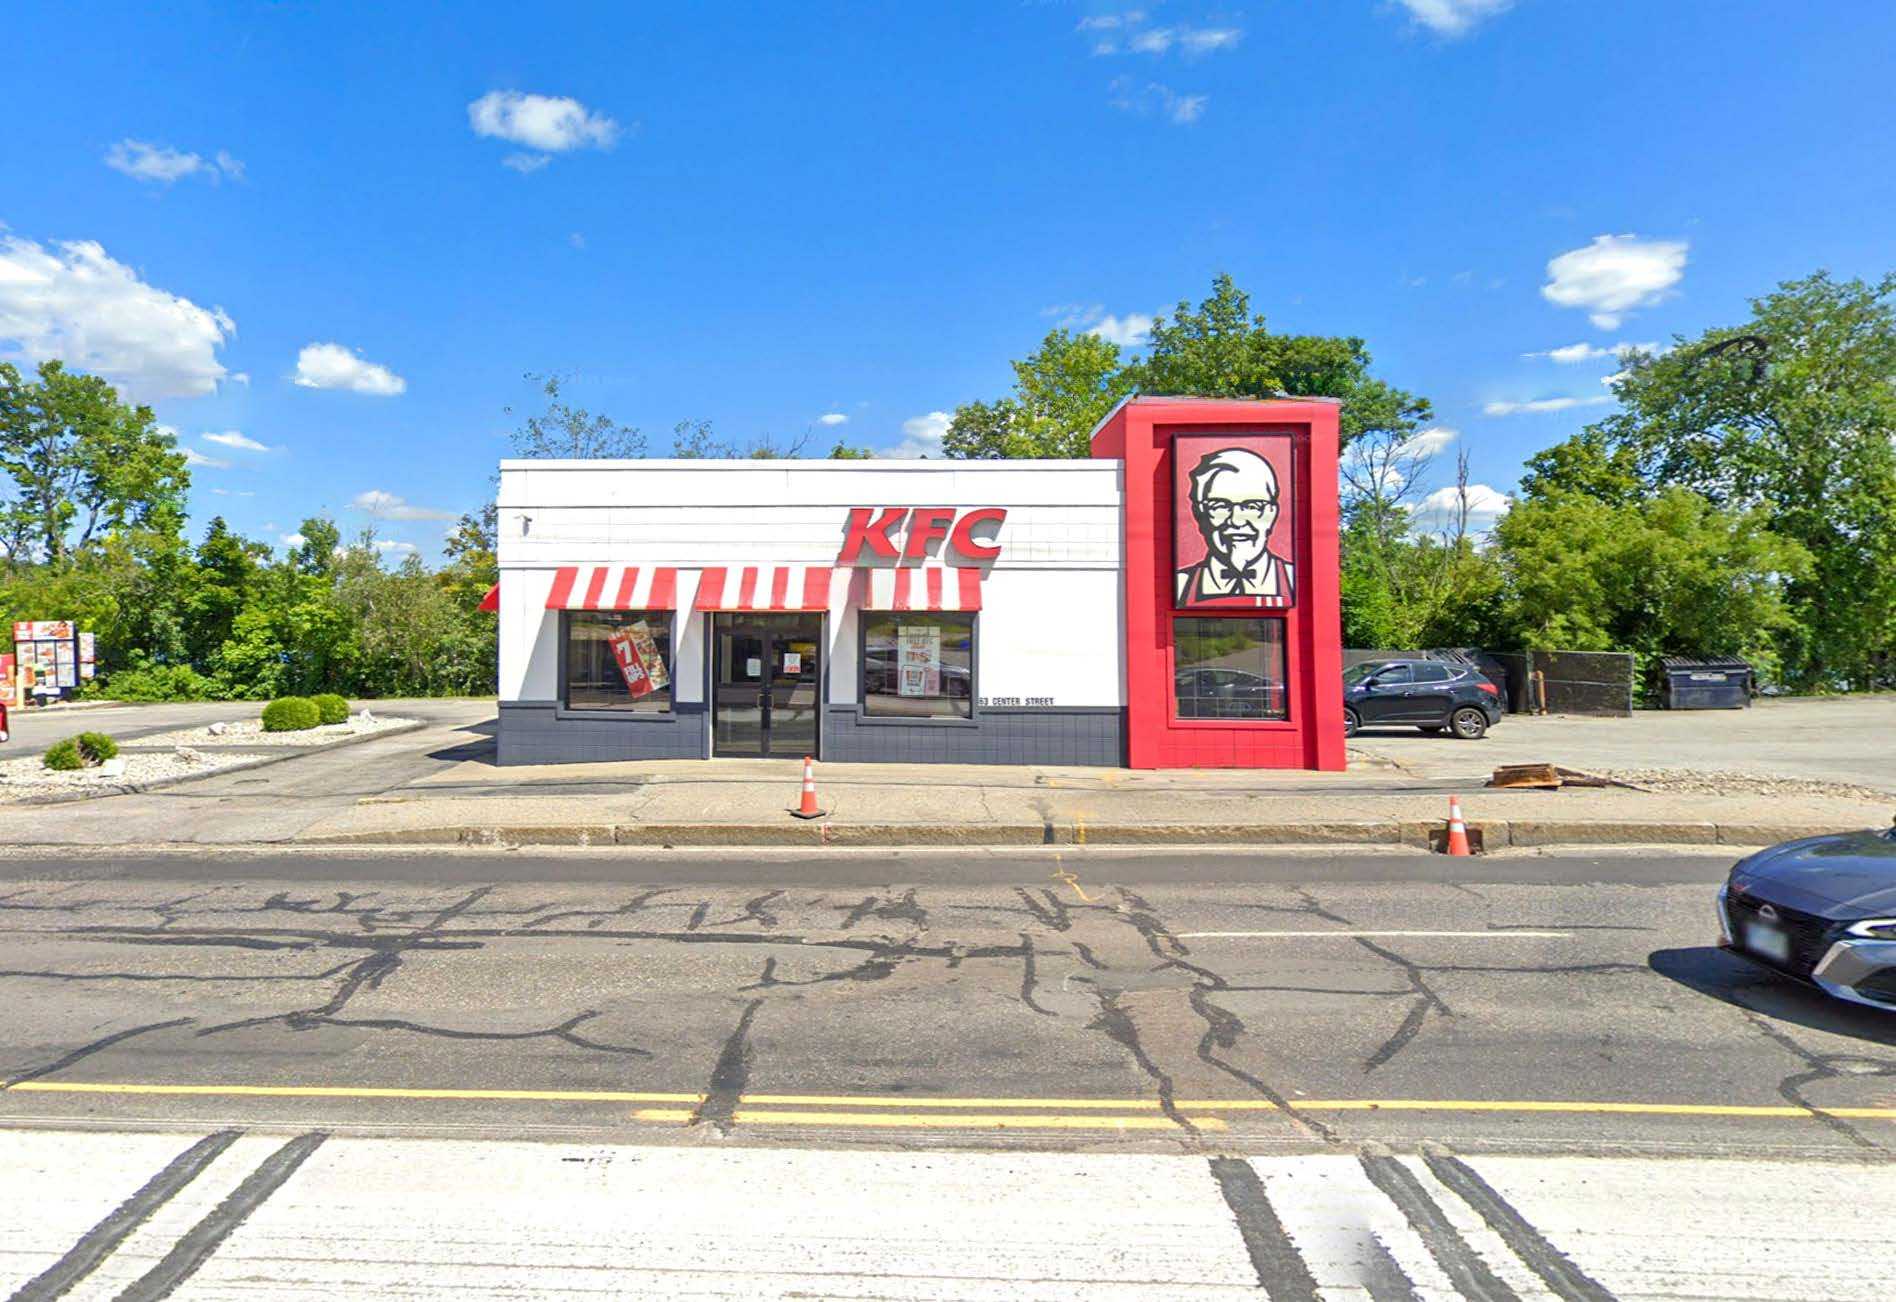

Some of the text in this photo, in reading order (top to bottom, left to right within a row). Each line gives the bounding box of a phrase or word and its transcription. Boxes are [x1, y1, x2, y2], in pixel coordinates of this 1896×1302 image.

[836, 508, 1008, 564] KFC
[615, 640, 633, 664] 7
[992, 697, 1021, 706] CENTER
[1025, 697, 1054, 706] STREET
